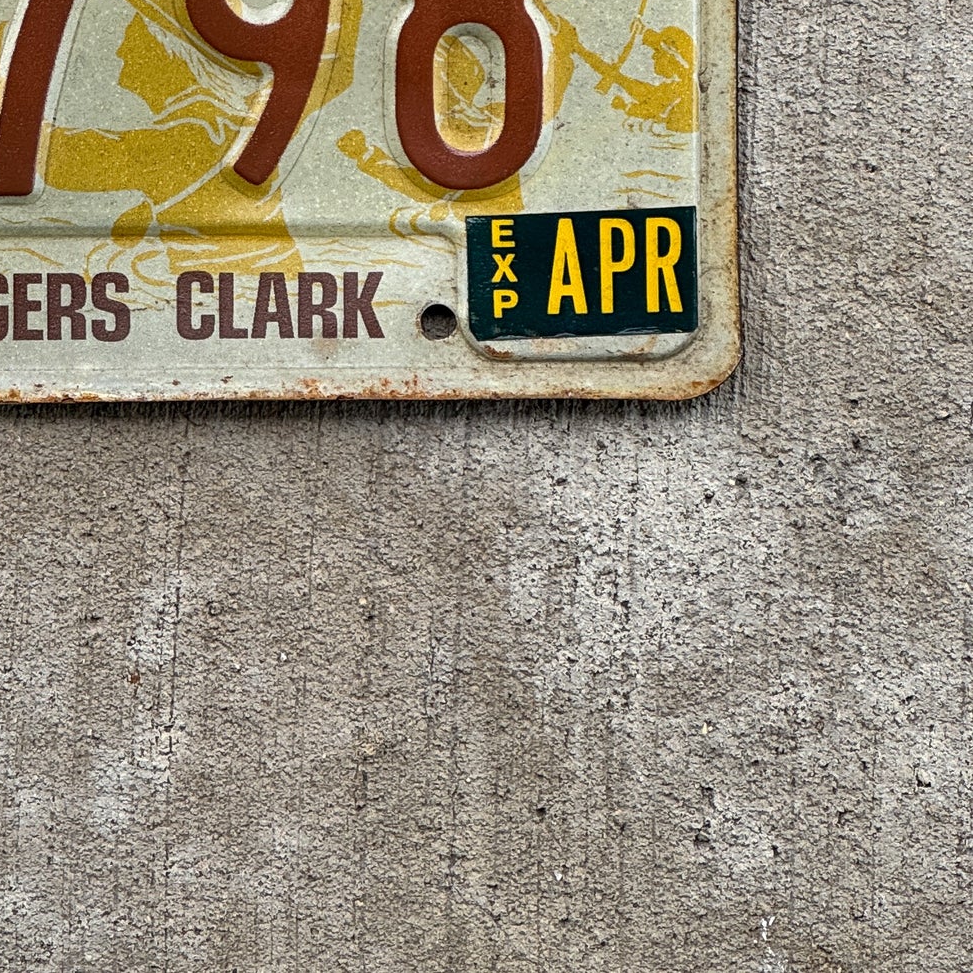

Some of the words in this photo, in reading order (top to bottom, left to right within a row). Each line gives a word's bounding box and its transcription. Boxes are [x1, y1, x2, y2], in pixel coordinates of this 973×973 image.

[176, 270, 385, 340] CLARK
[491, 219, 519, 319] EXP
[547, 217, 683, 314] APR
